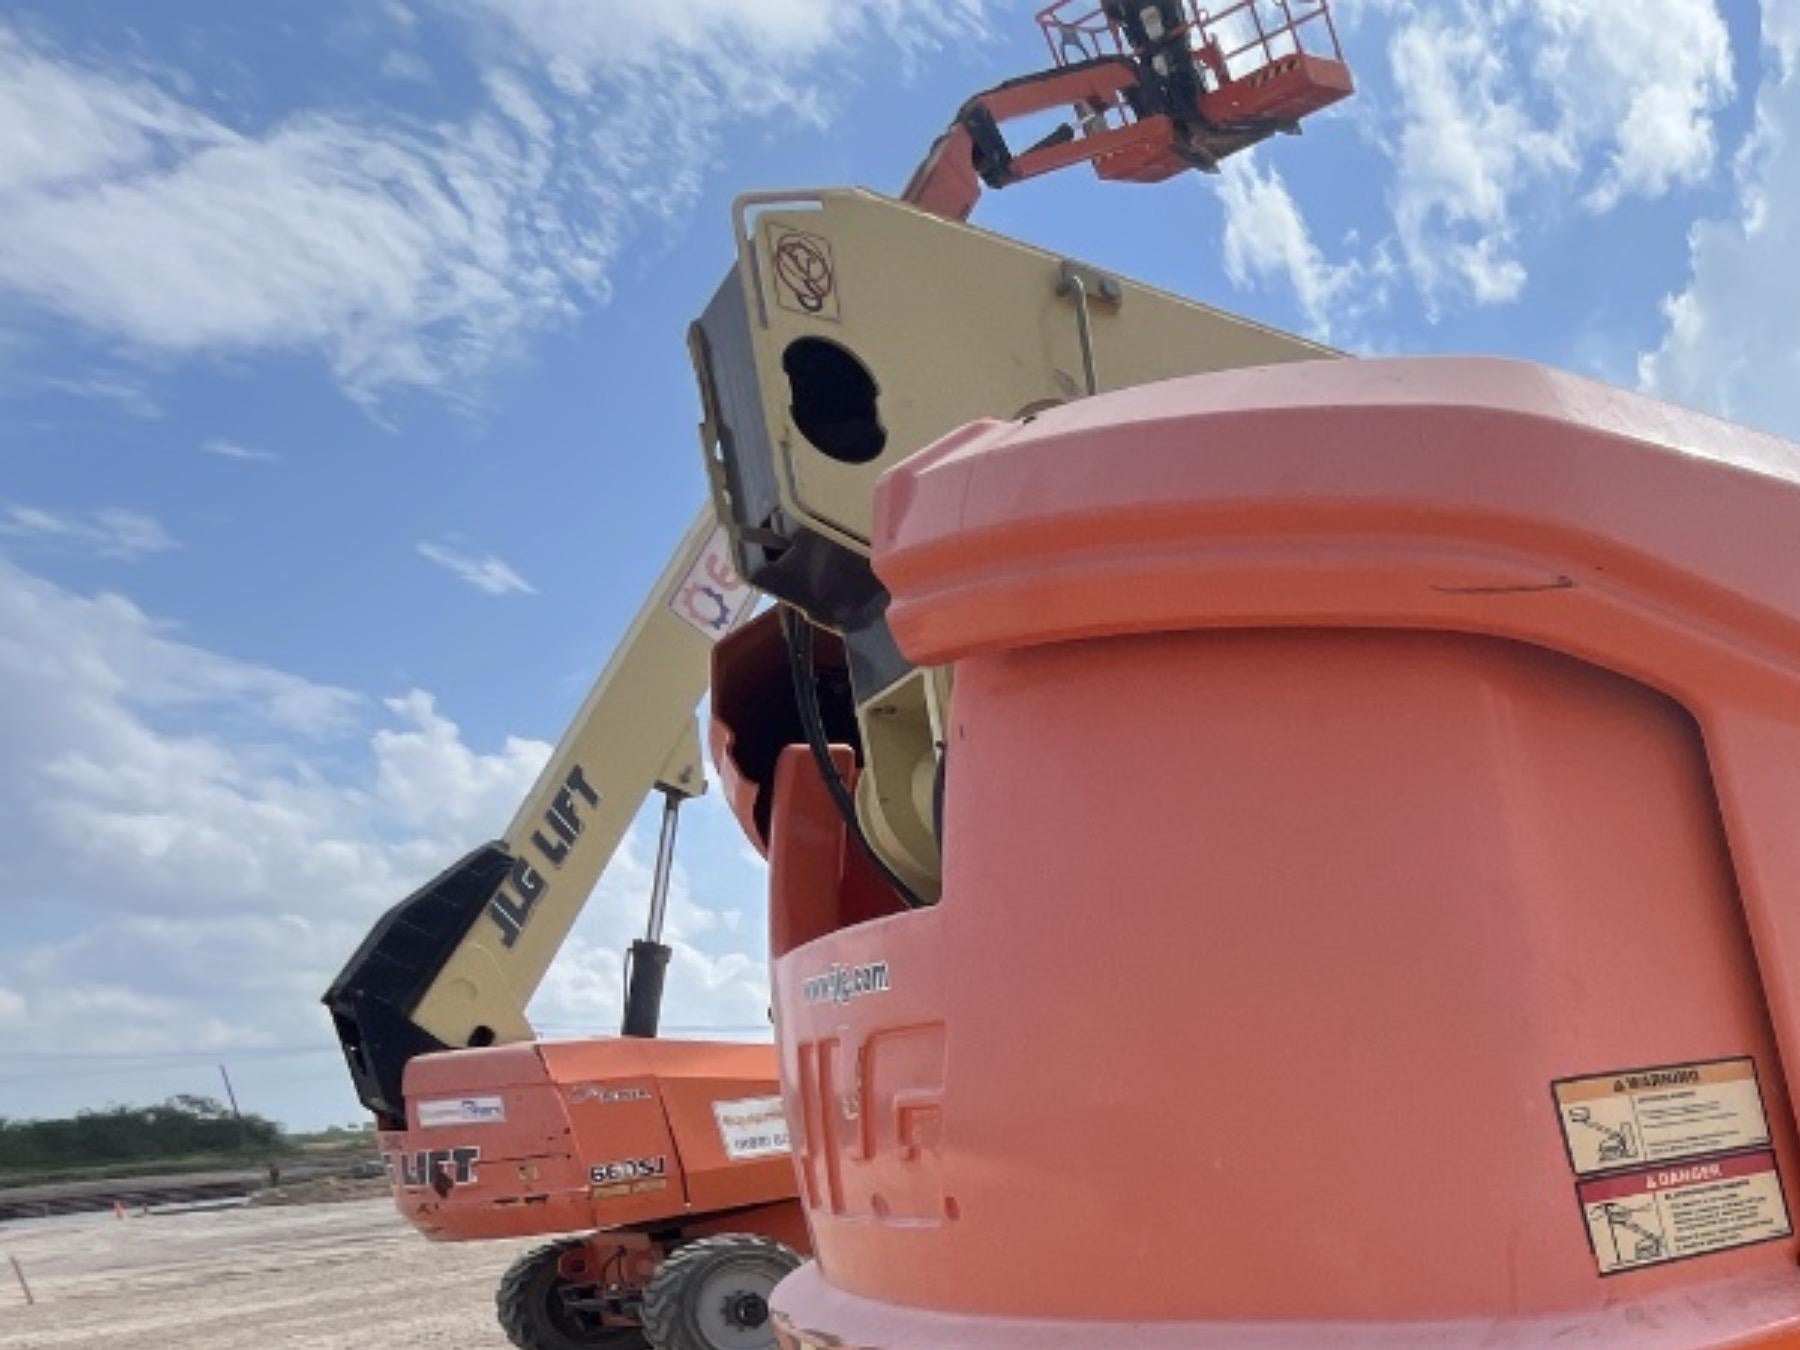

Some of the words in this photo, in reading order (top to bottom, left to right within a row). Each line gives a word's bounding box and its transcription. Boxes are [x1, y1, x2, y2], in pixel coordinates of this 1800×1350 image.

[488, 855, 547, 949] JLG
[531, 763, 600, 868] LIFT
[400, 1146, 481, 1191] LIFT
